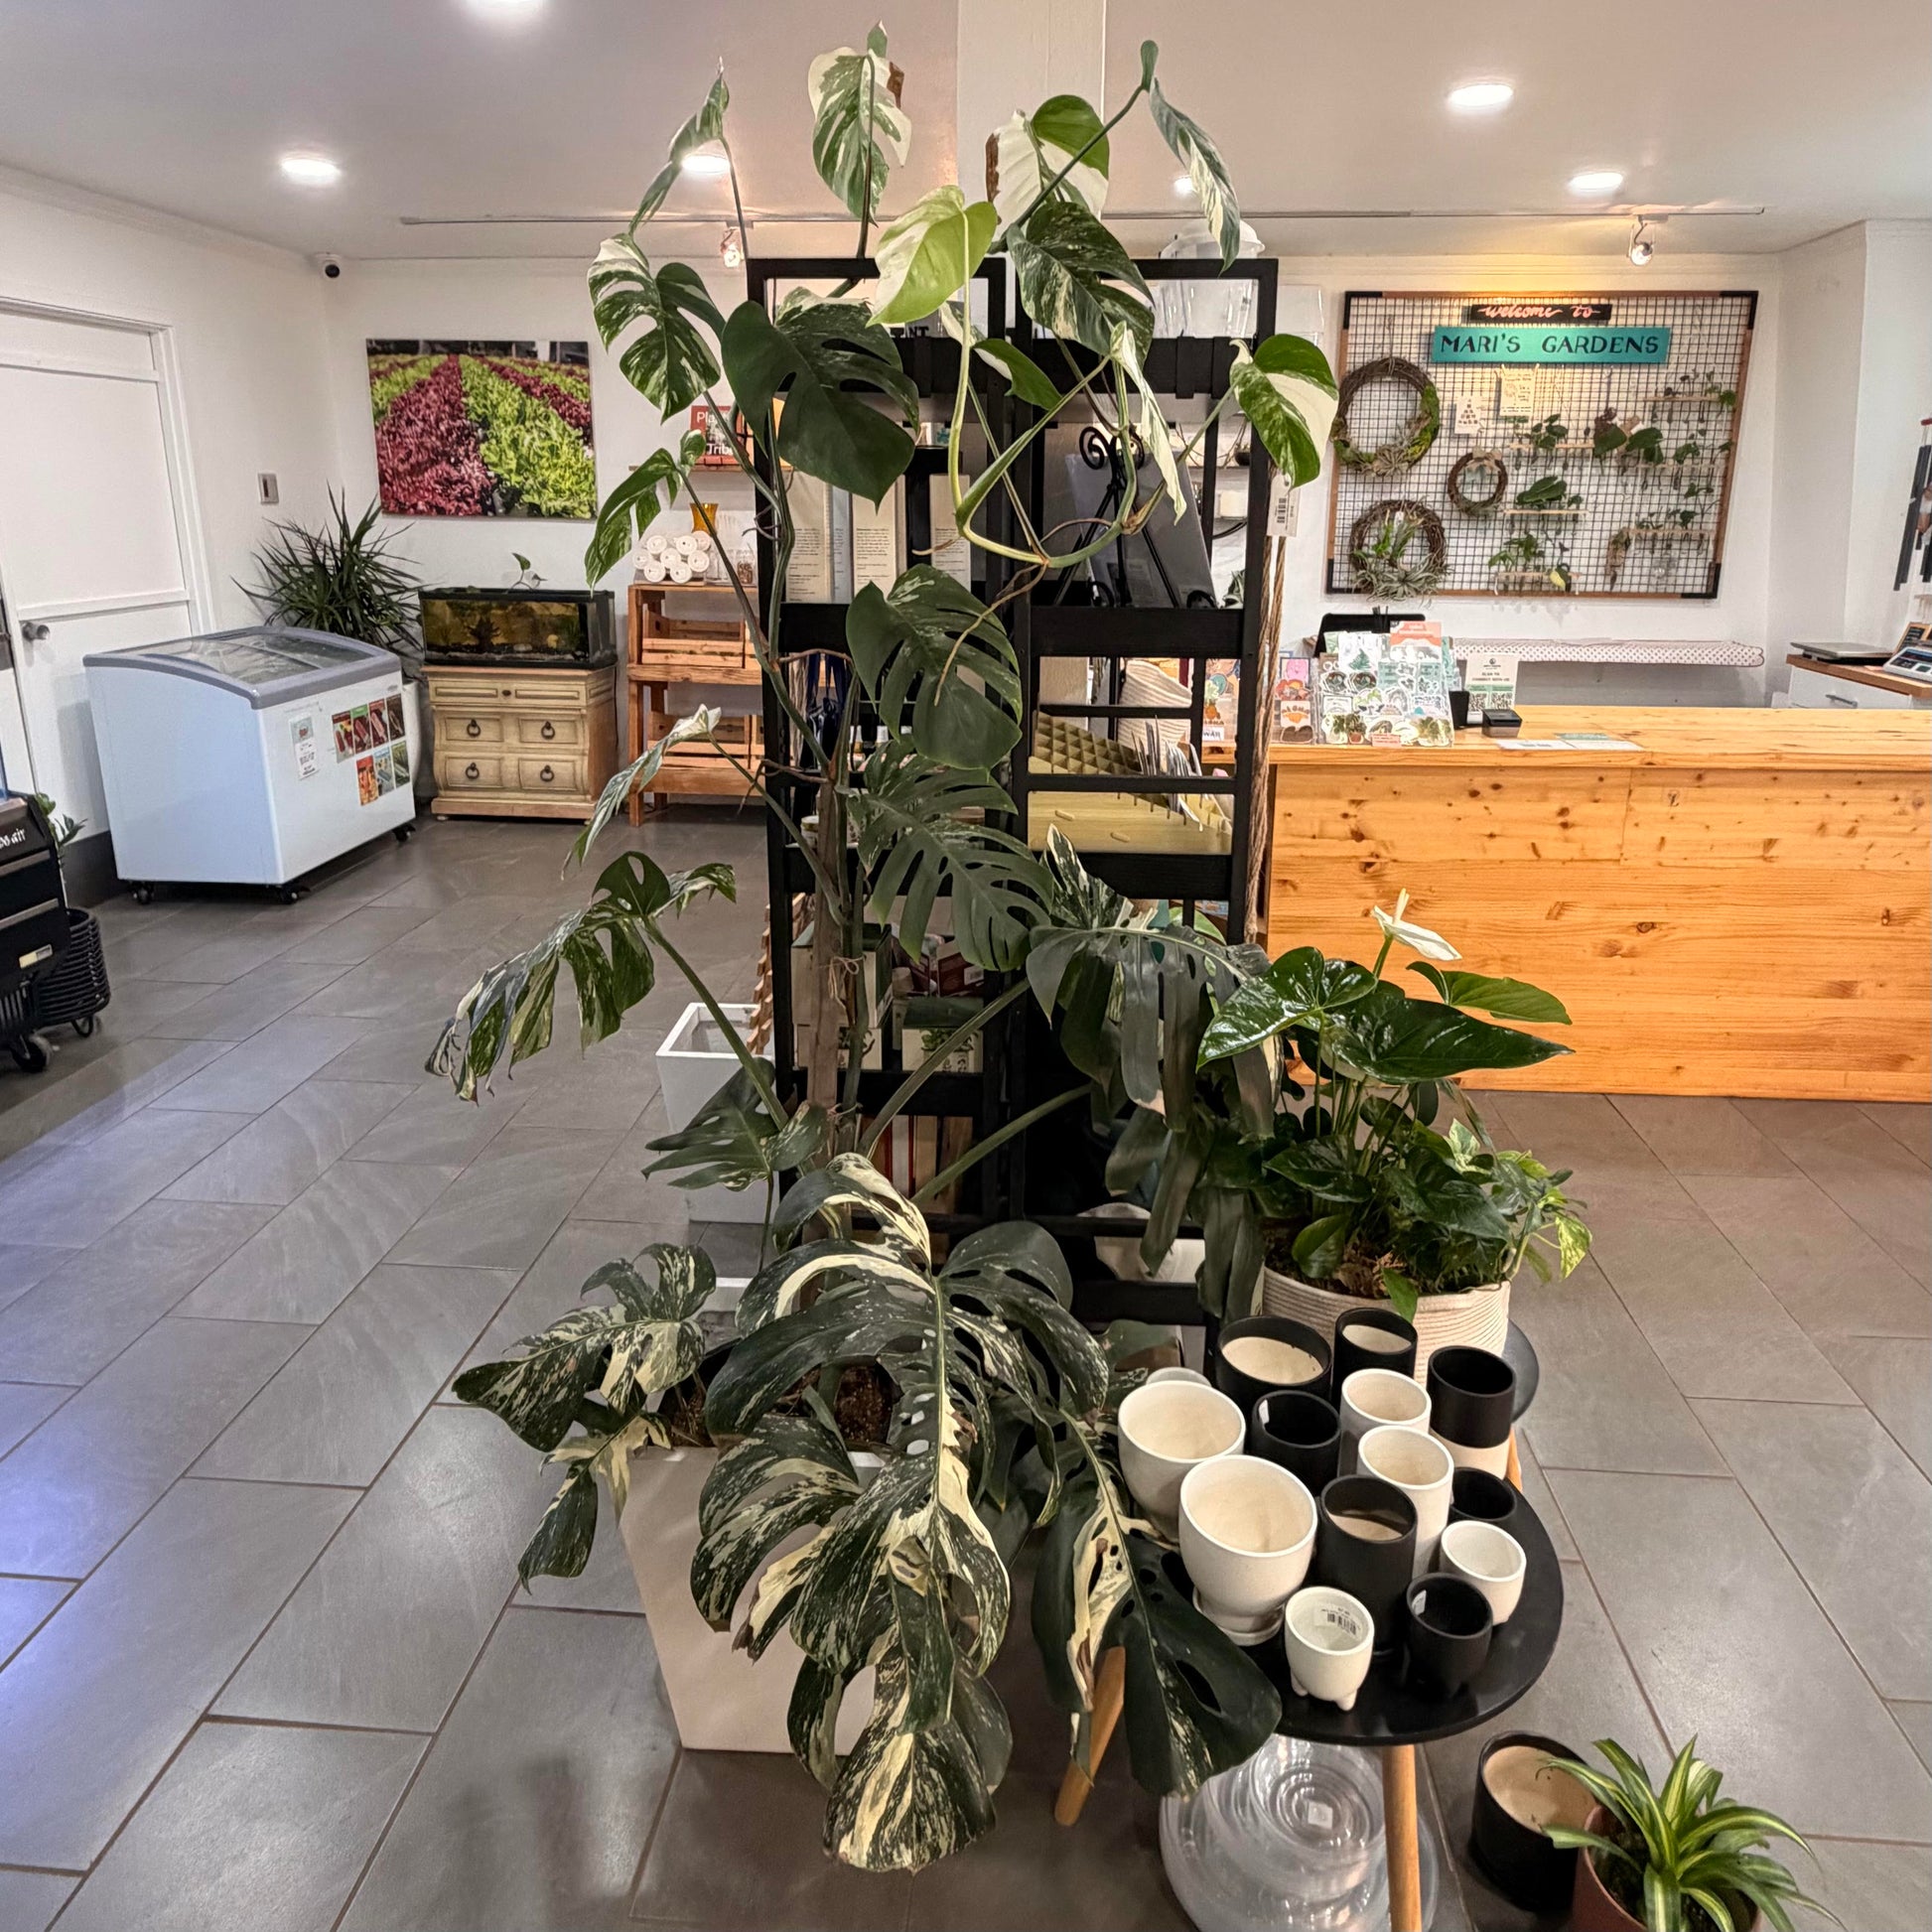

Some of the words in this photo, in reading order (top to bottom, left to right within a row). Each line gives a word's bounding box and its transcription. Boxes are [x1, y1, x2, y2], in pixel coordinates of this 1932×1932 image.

[1477, 304, 1564, 319] welcome
[1570, 306, 1601, 319] to
[1441, 333, 1521, 352] MARI'S
[1541, 335, 1659, 353] GARDENS
